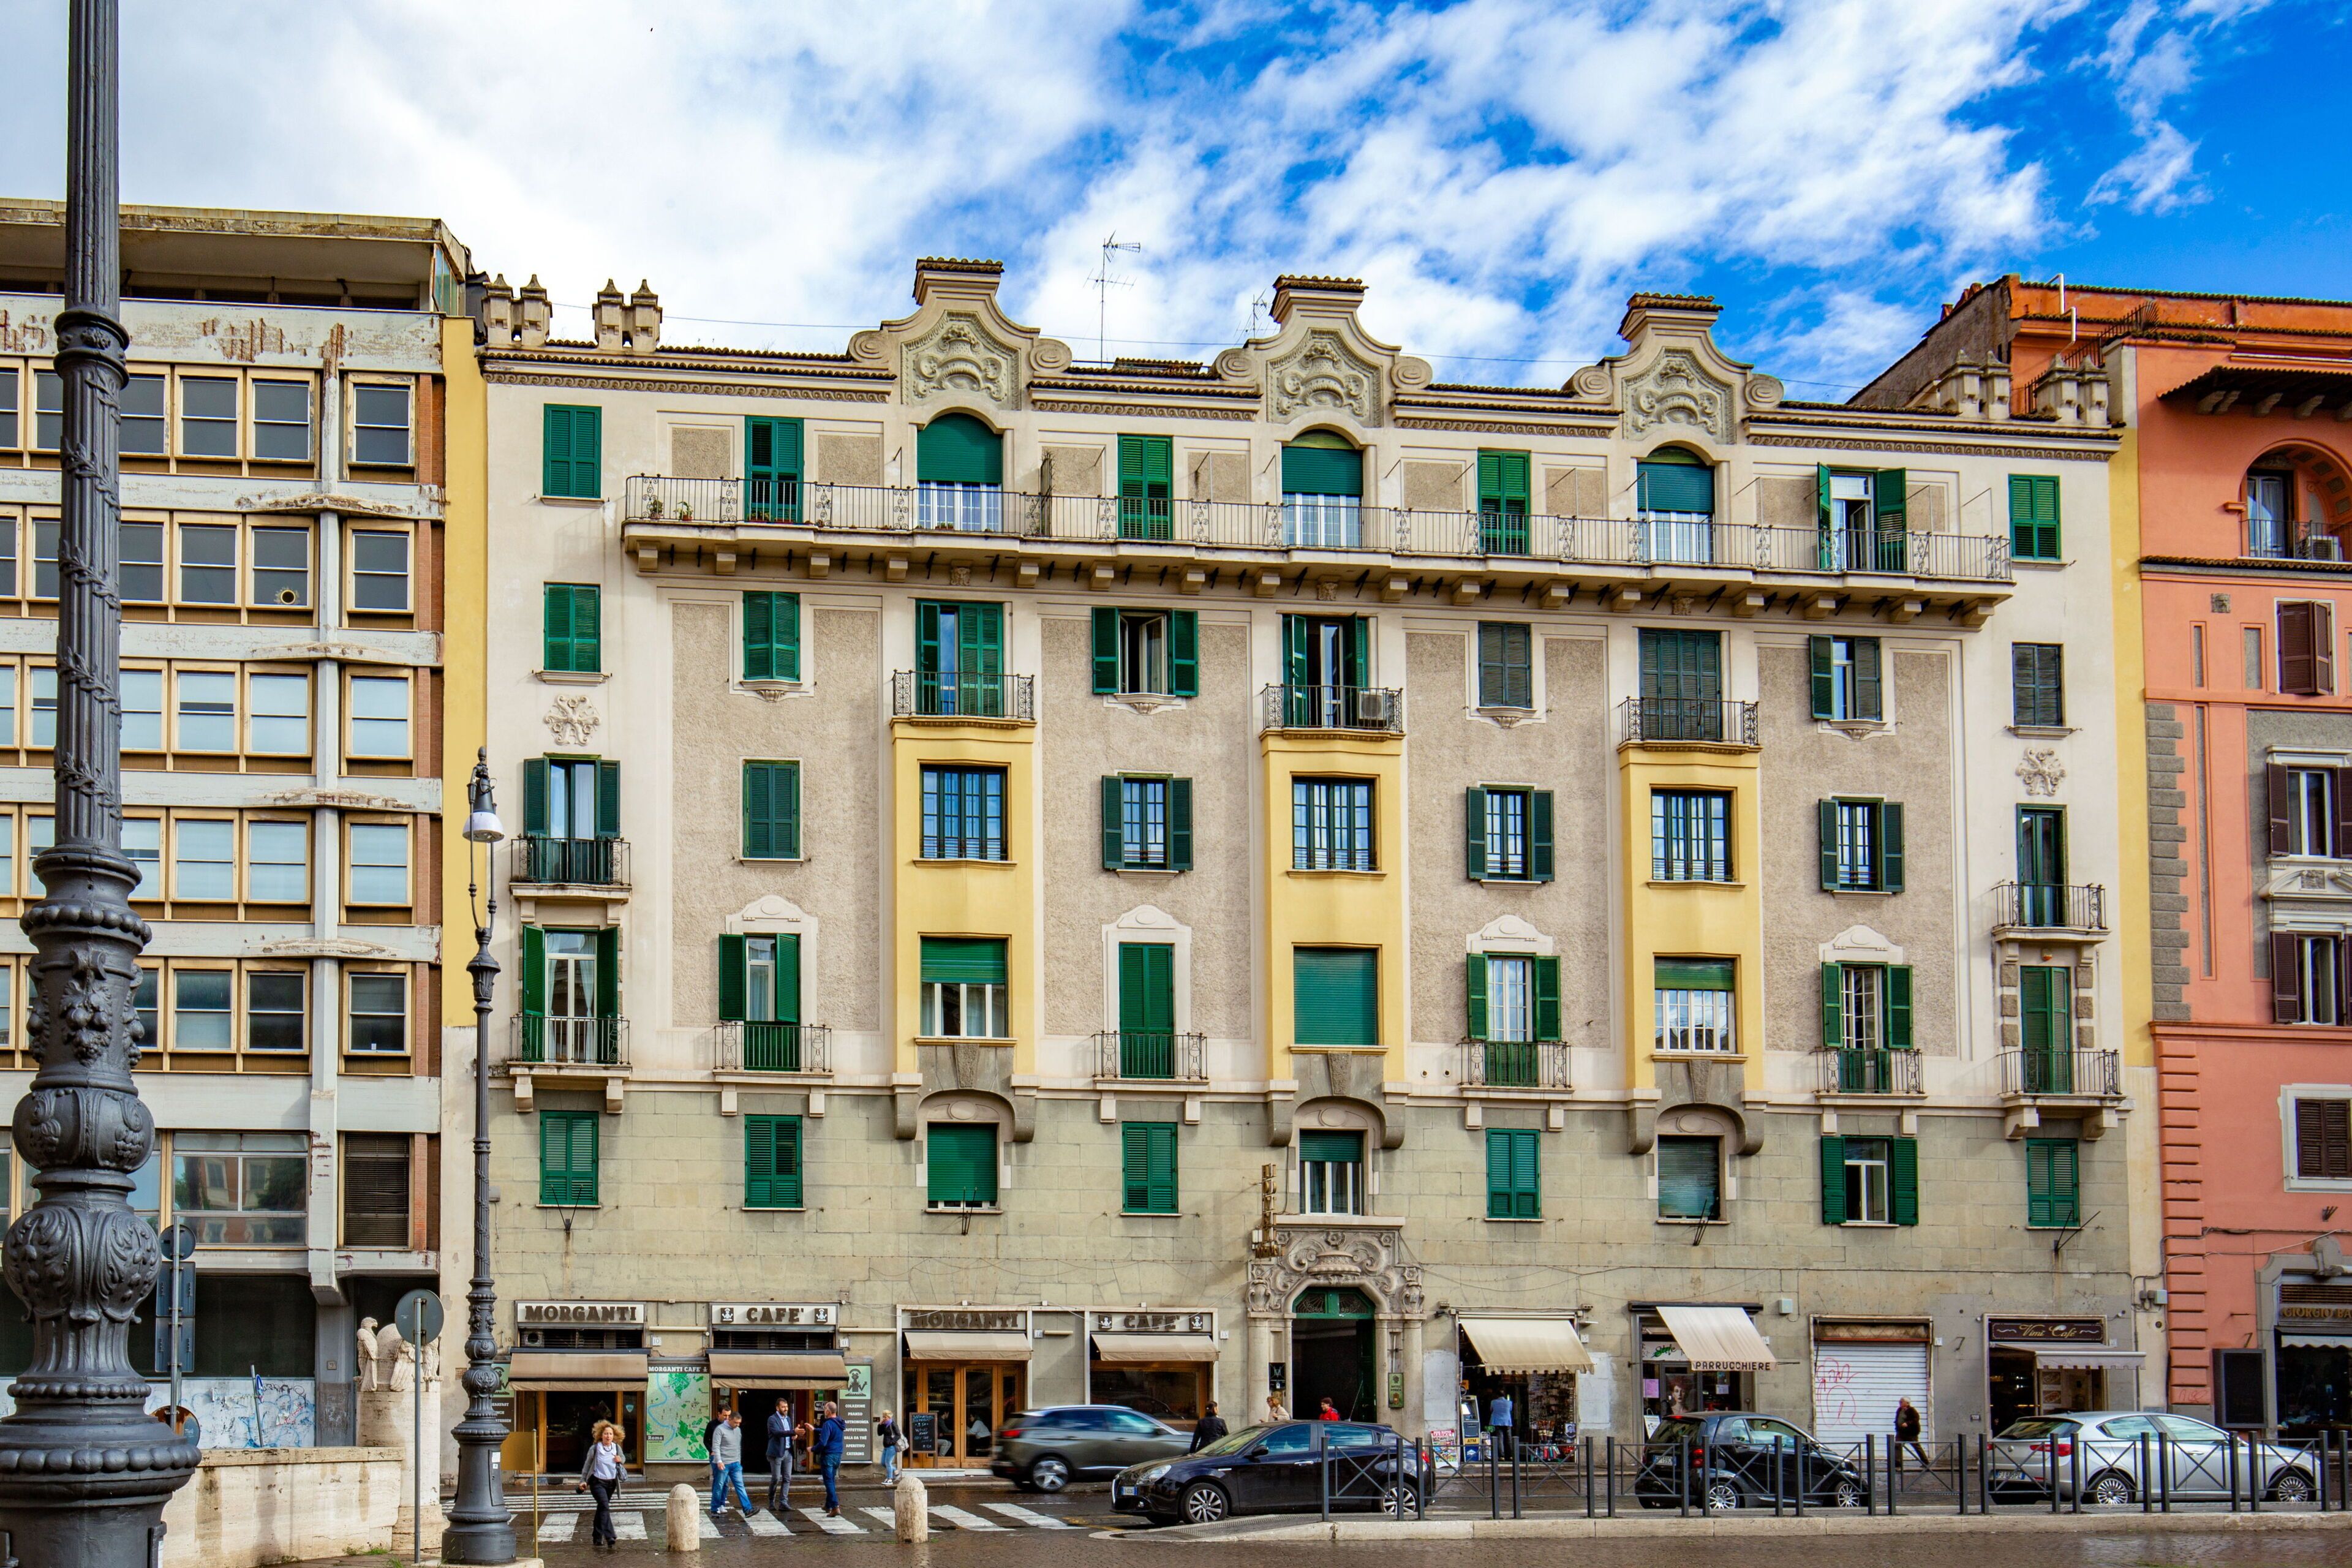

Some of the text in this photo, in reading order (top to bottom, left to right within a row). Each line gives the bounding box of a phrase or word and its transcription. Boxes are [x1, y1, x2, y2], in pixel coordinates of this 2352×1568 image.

[524, 1305, 637, 1321] MORGANTI
[2282, 1307, 2332, 1317] GIORGIO
[910, 1311, 1018, 1328] MORGANTI
[1695, 1361, 1771, 1371] PARRUCCHIERE
